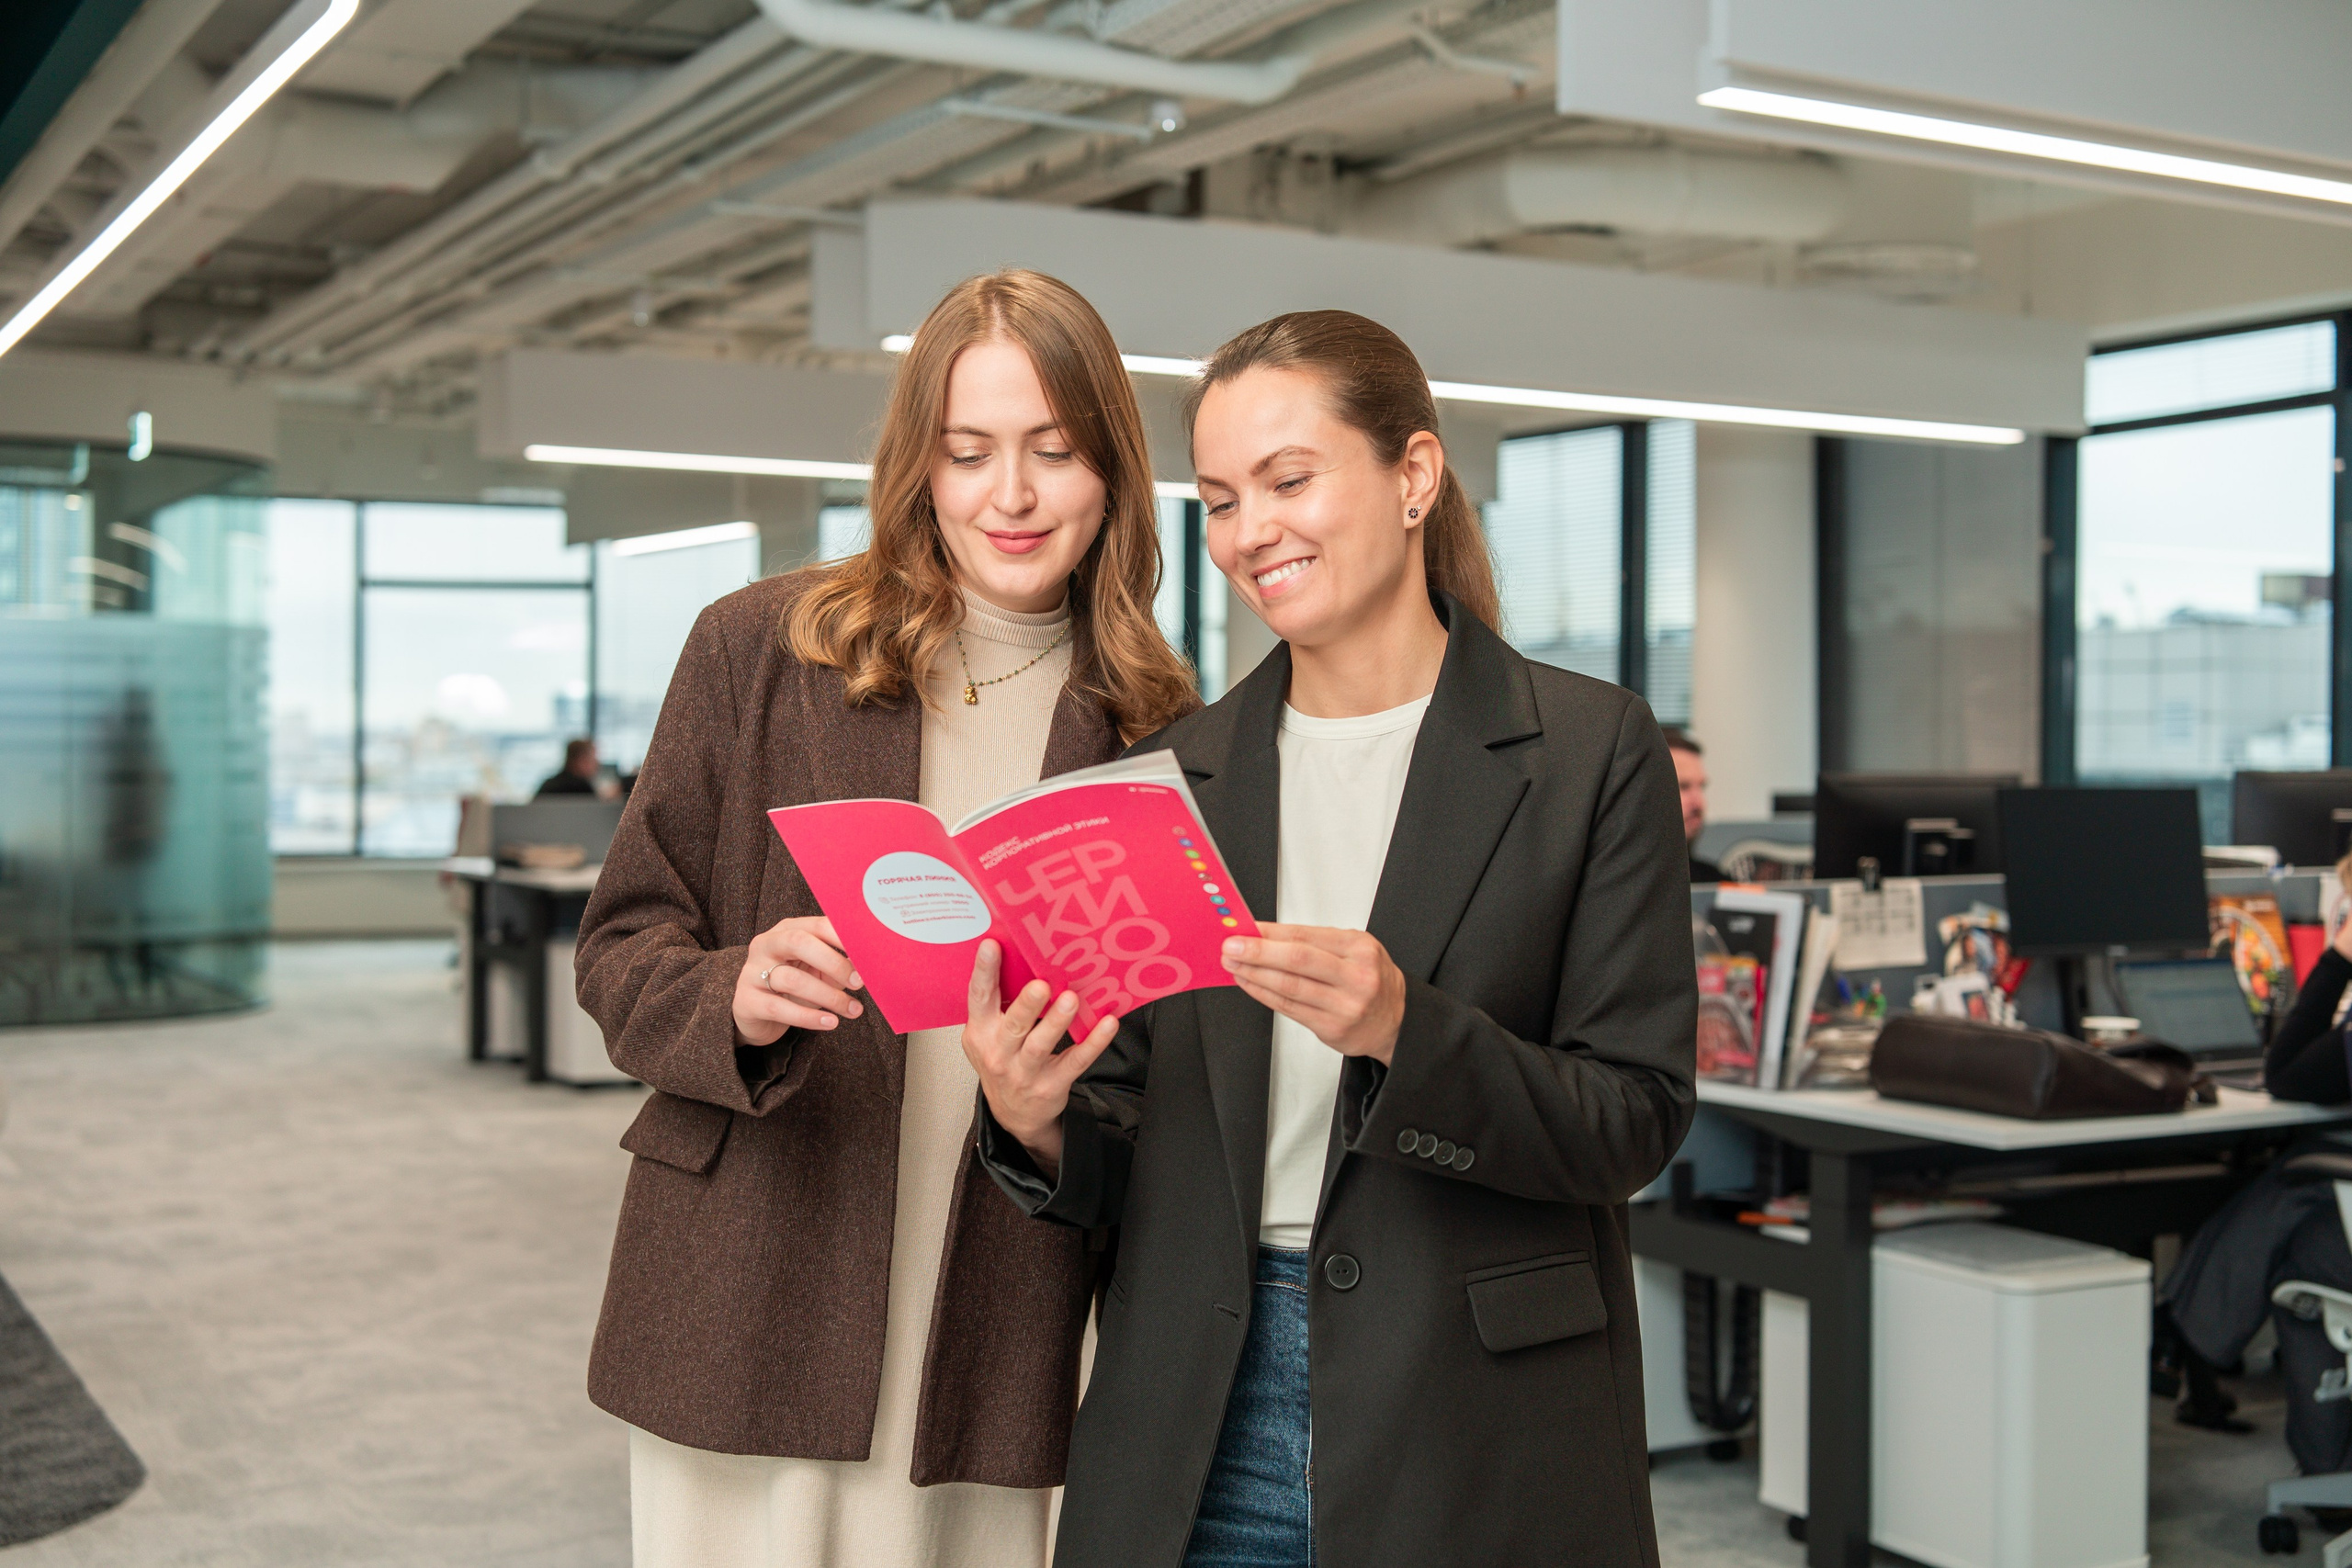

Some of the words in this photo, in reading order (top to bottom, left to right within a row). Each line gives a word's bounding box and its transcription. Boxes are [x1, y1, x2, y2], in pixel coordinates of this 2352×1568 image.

[978, 836, 1021, 863] КОДЕКС
[982, 823, 1073, 870] КОРПОРАТИВНОЙ
[1073, 816, 1111, 830] ЭТИКИ
[877, 875, 923, 886] ГОРЯЧАЯ
[995, 840, 1126, 906] ЧЕР
[1022, 874, 1148, 959] КИ
